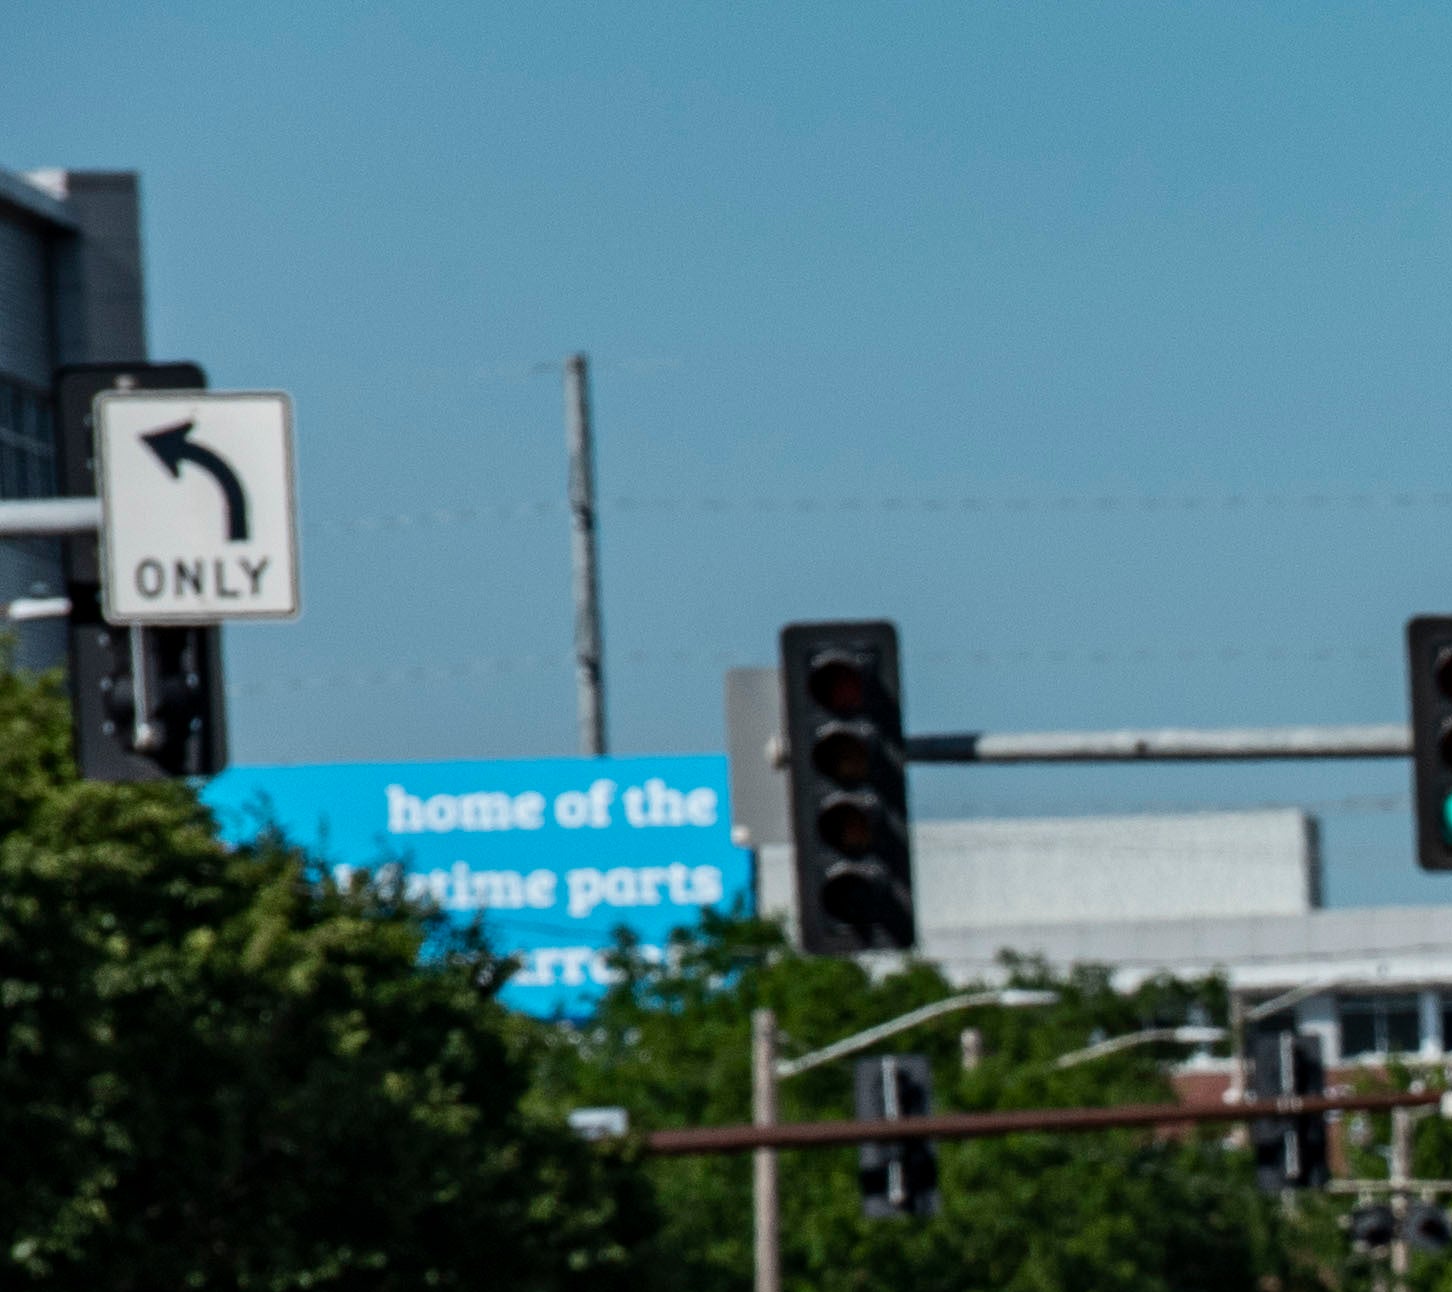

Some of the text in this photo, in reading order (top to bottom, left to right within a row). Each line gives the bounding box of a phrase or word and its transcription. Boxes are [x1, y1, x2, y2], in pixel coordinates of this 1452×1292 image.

[135, 556, 271, 599] ONLY
[386, 776, 718, 834] home of the
[566, 860, 724, 918] parts
